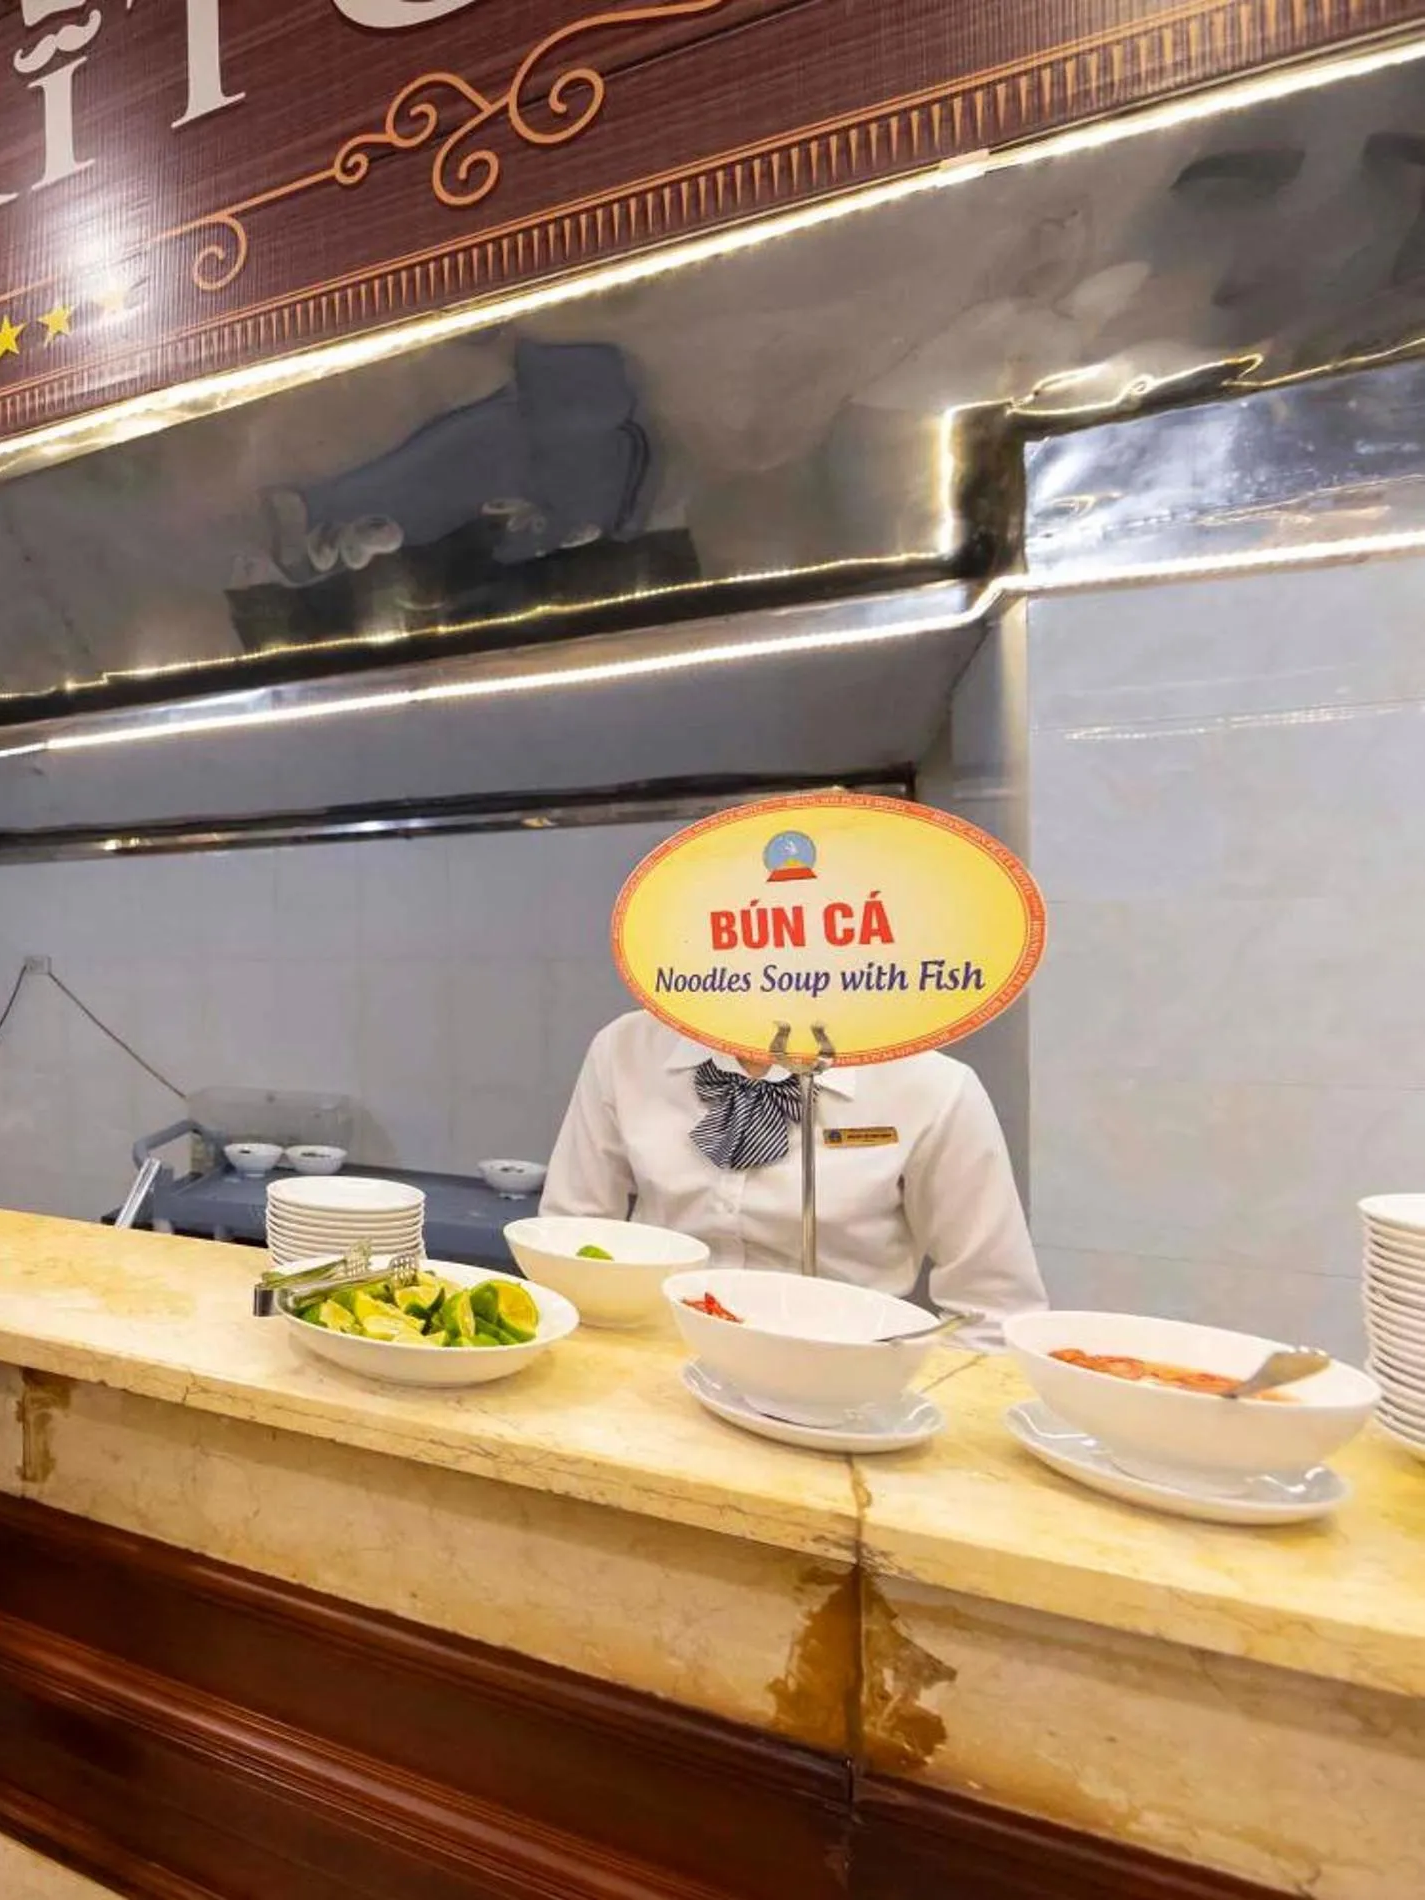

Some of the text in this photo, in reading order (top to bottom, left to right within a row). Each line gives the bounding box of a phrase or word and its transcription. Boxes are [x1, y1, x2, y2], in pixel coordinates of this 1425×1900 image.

[710, 890, 895, 950] BÚN CÁ
[655, 959, 986, 997] Noodles Soup with Fish
